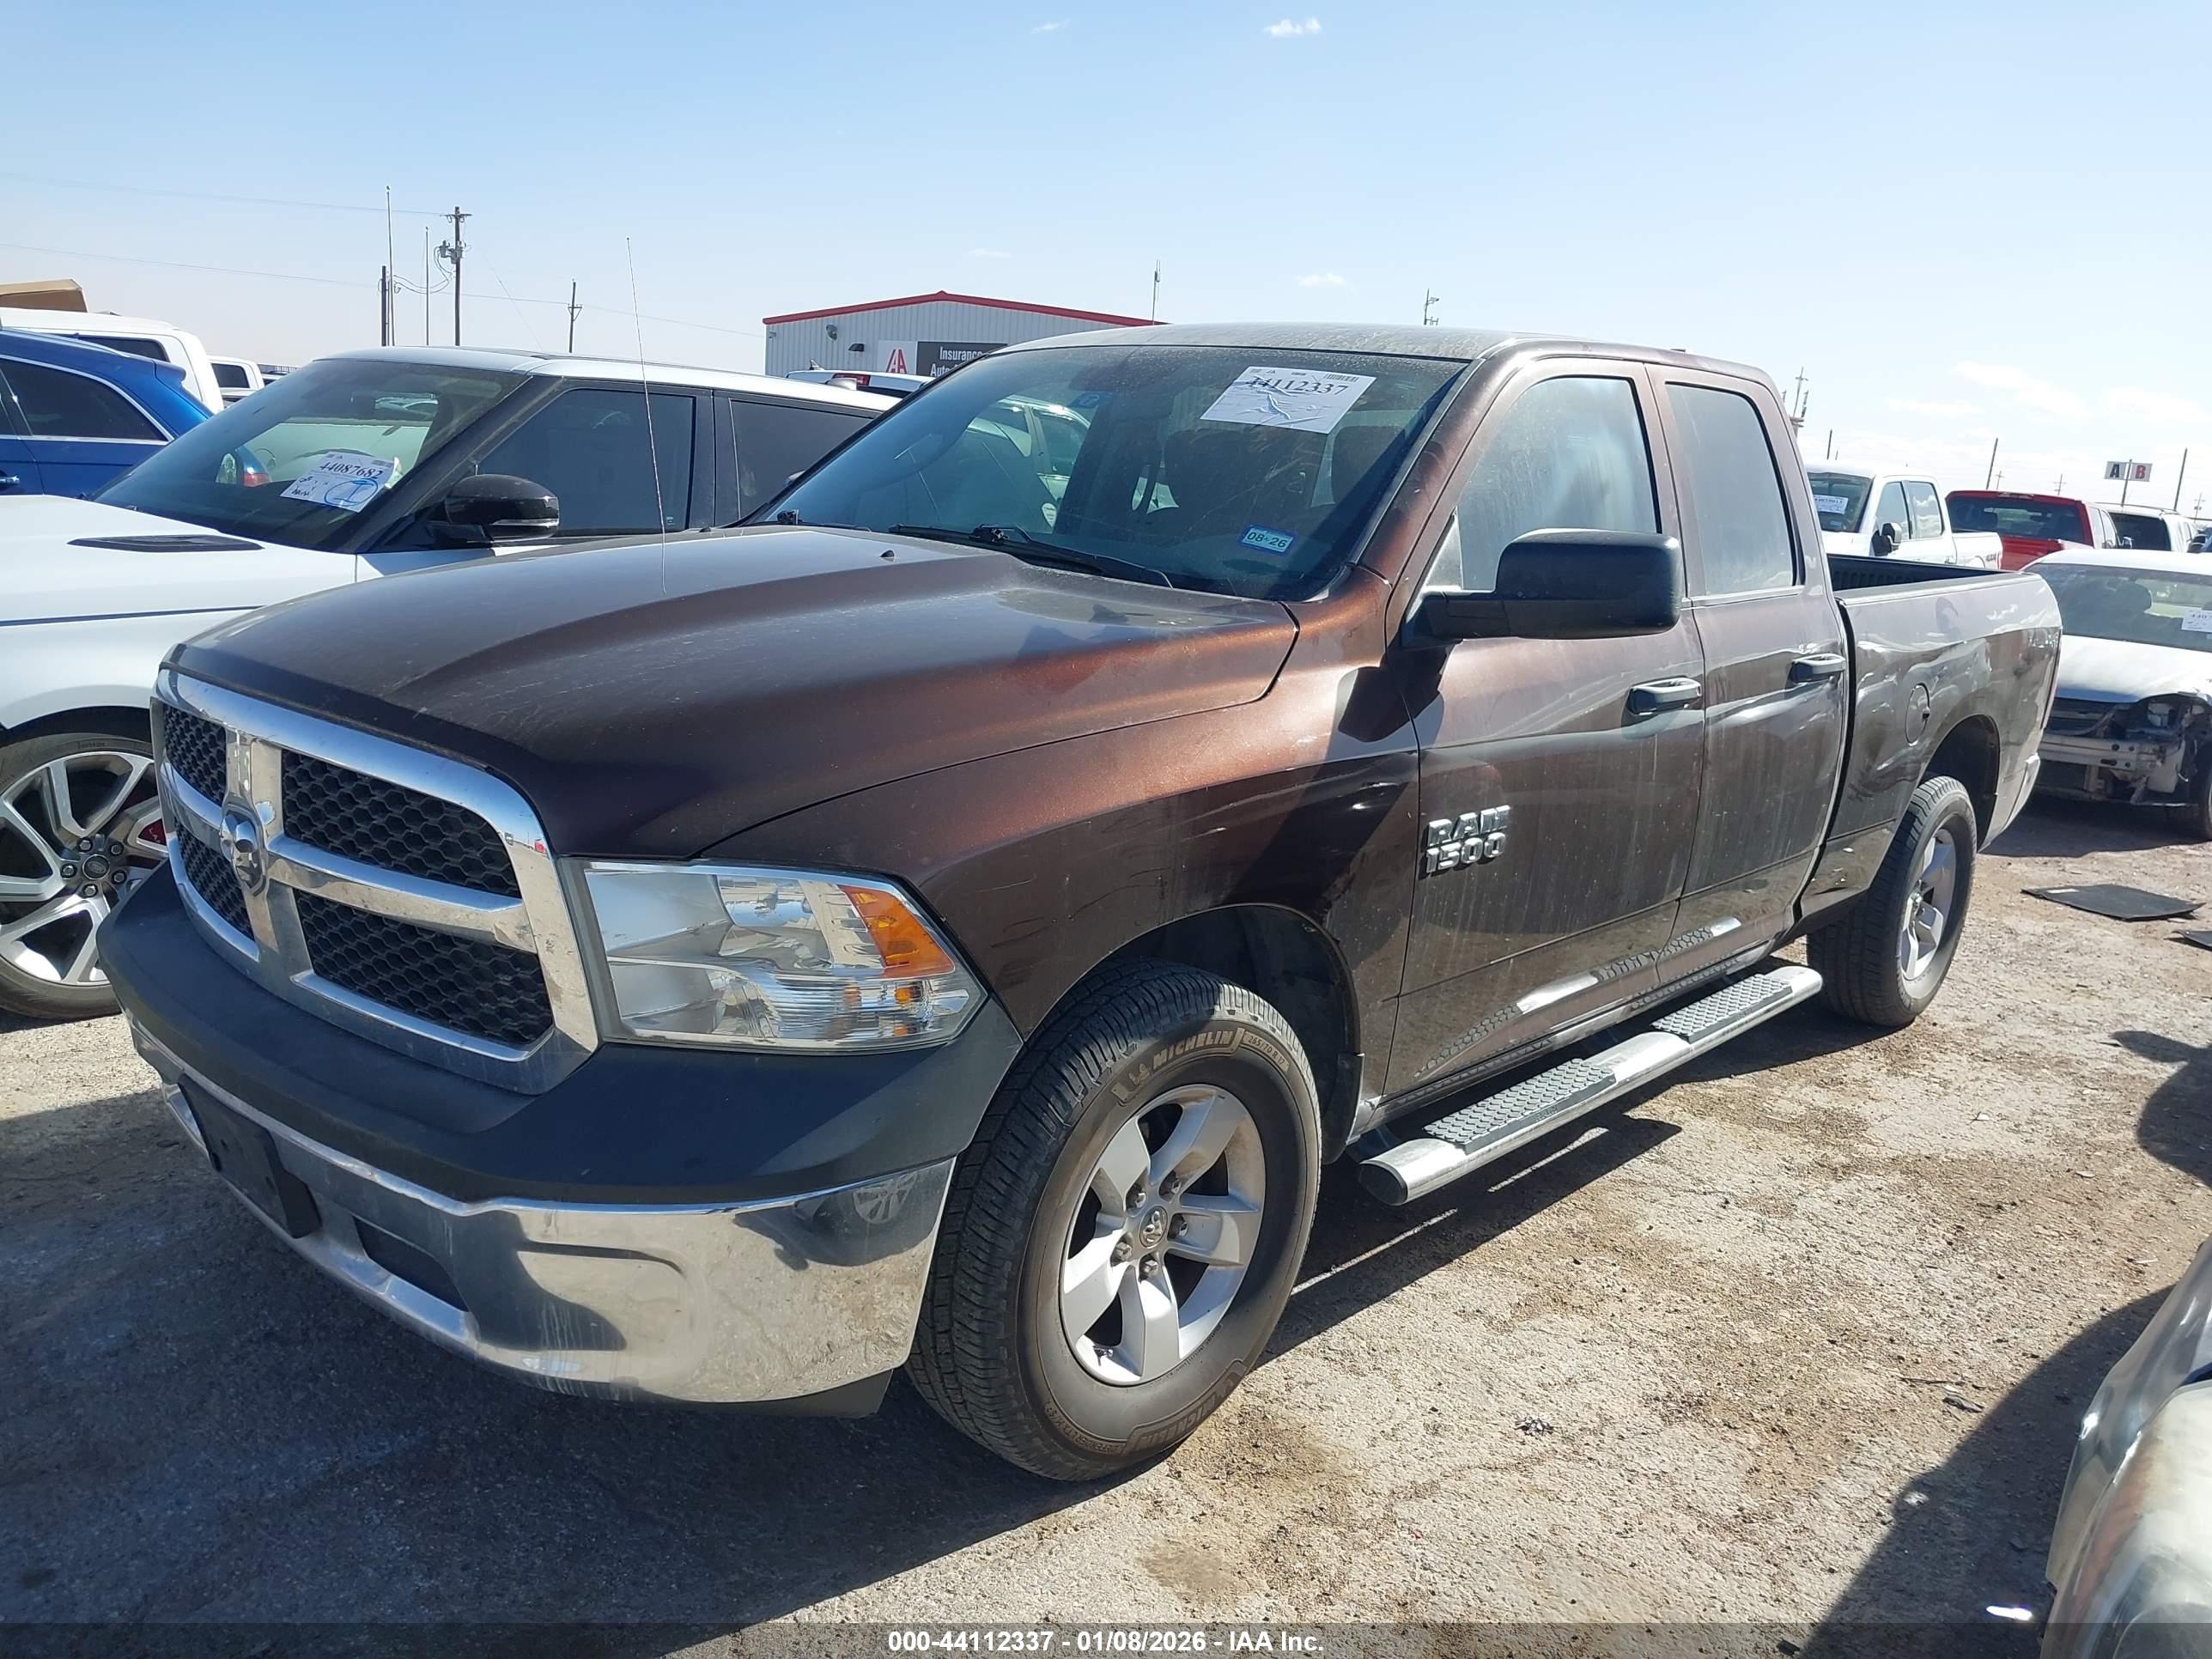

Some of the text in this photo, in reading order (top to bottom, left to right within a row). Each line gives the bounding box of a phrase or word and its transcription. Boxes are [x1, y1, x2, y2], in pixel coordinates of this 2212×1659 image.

[319, 462, 383, 479] 44087682
[2109, 464, 2119, 478] A
[2135, 465, 2146, 479] B
[1428, 805, 1510, 847] RAM
[1426, 832, 1506, 872] 1500
[1152, 1030, 1235, 1070] MICHELIN
[1249, 1036, 1273, 1054] 265/70
